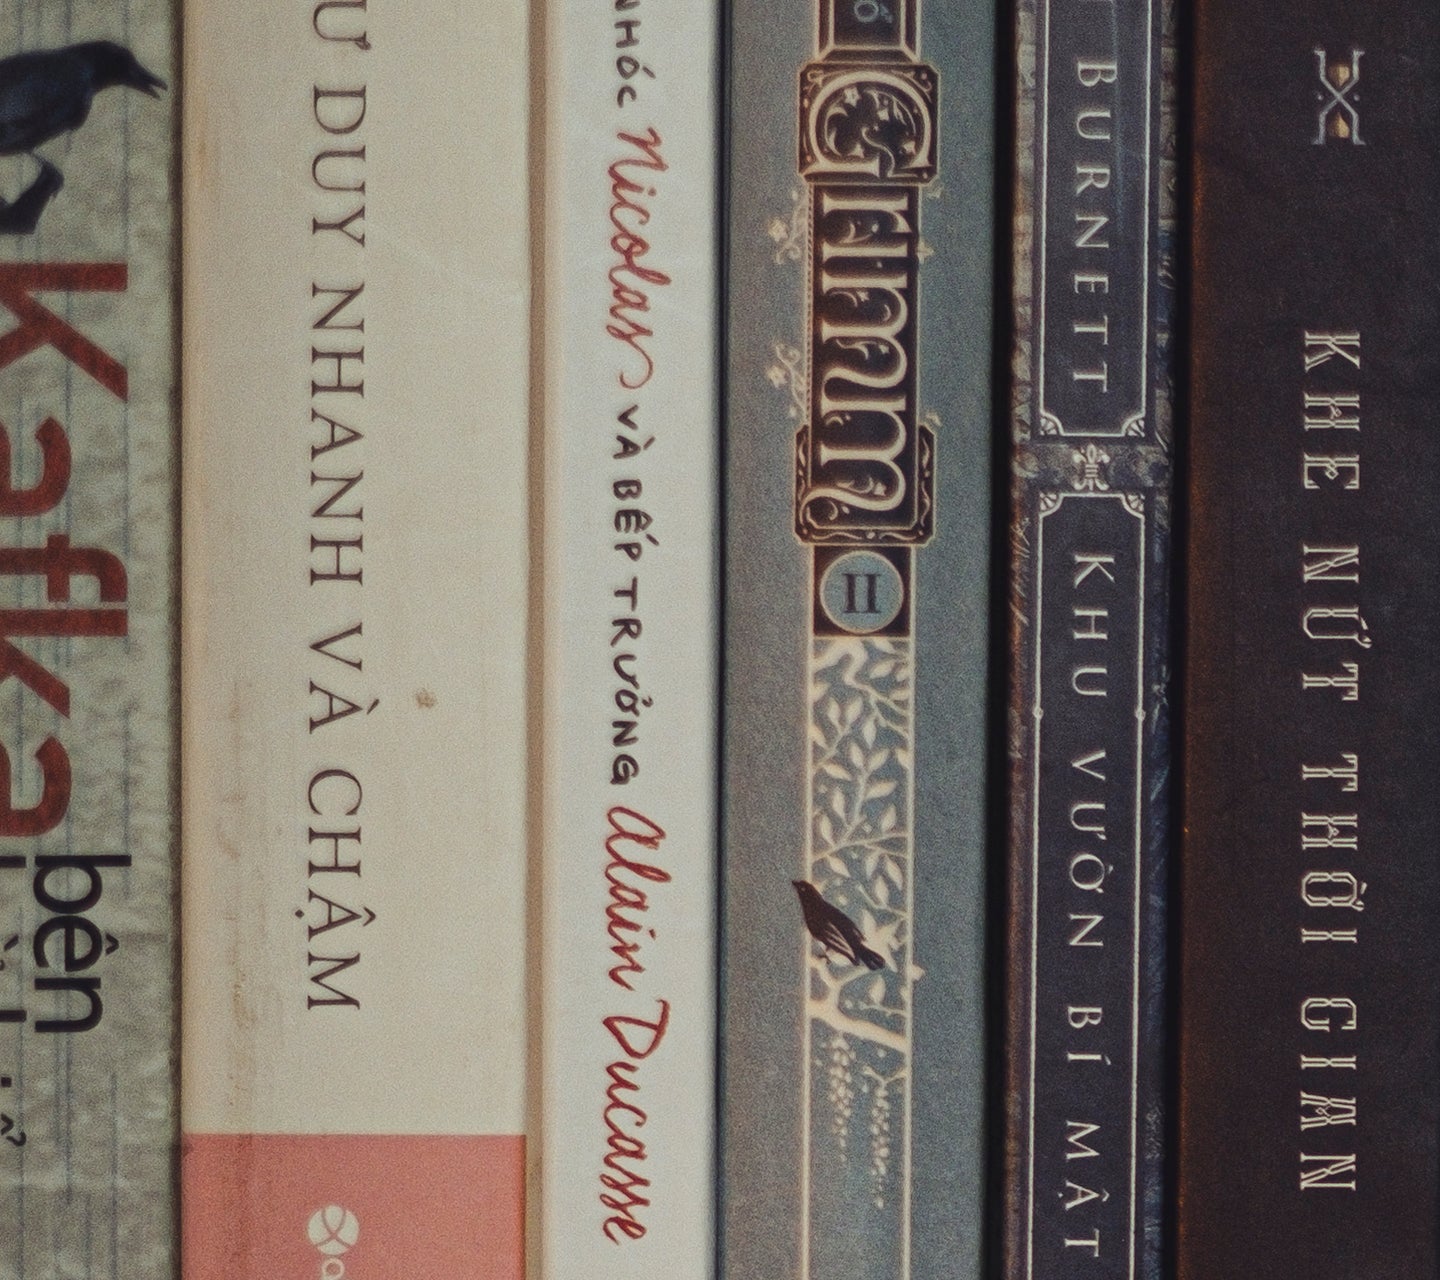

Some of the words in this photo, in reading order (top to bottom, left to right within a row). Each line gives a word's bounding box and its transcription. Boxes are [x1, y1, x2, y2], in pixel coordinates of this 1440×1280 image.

[310, 0, 371, 50] Ư
[310, 85, 366, 248] DUY
[1075, 58, 1118, 393] BURNETT
[608, 127, 672, 390] Nicolas
[310, 283, 366, 588] NHANH
[1305, 330, 1361, 490] KHE
[612, 478, 660, 562] BẾP
[310, 622, 380, 735] VÀ
[610, 575, 654, 786] TRƯỞNG
[1072, 553, 1116, 697] KHU
[1303, 545, 1373, 702] NỨT
[294, 766, 376, 1012] CHẬM
[1068, 750, 1110, 948] VƯỜN
[1302, 752, 1365, 945] THỜI
[33, 853, 132, 1034] bên
[602, 999, 670, 1245] Ducasse
[1068, 1007, 1112, 1062] BÍ
[1301, 996, 1357, 1192] GIAN
[1059, 1121, 1112, 1256] MẬT
